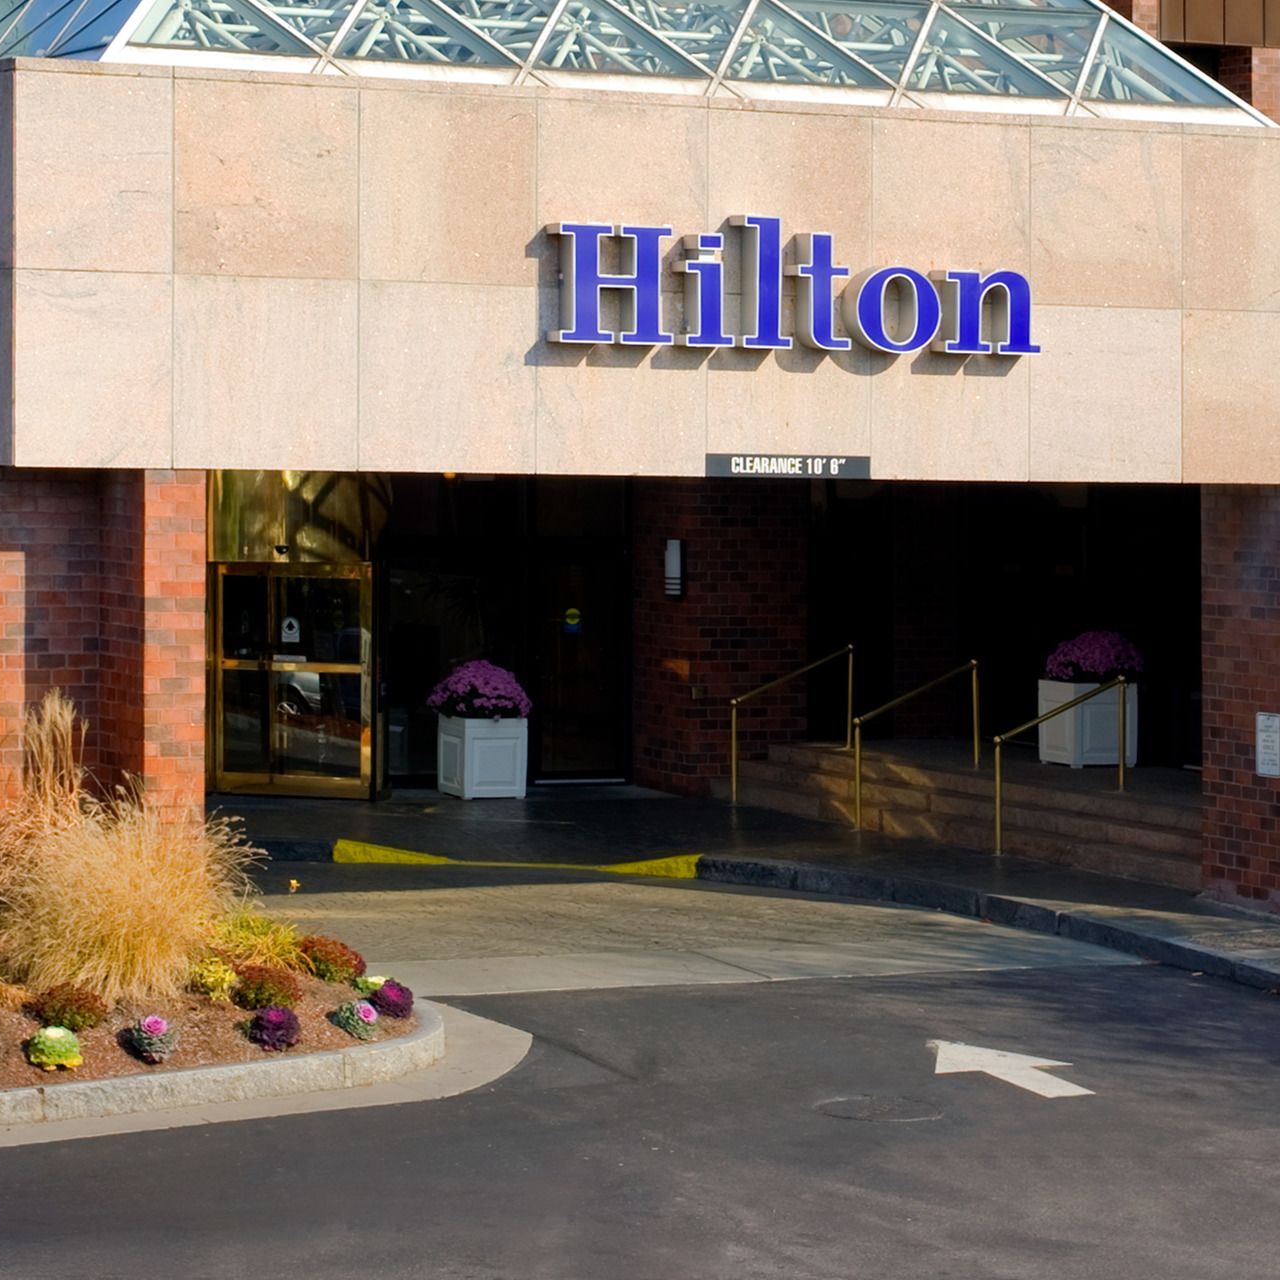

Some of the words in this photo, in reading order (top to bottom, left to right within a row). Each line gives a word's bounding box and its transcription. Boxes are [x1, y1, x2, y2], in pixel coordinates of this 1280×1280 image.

[558, 214, 1042, 355] Hilton
[731, 456, 802, 474] CLEARANCE
[806, 457, 827, 475] 10'
